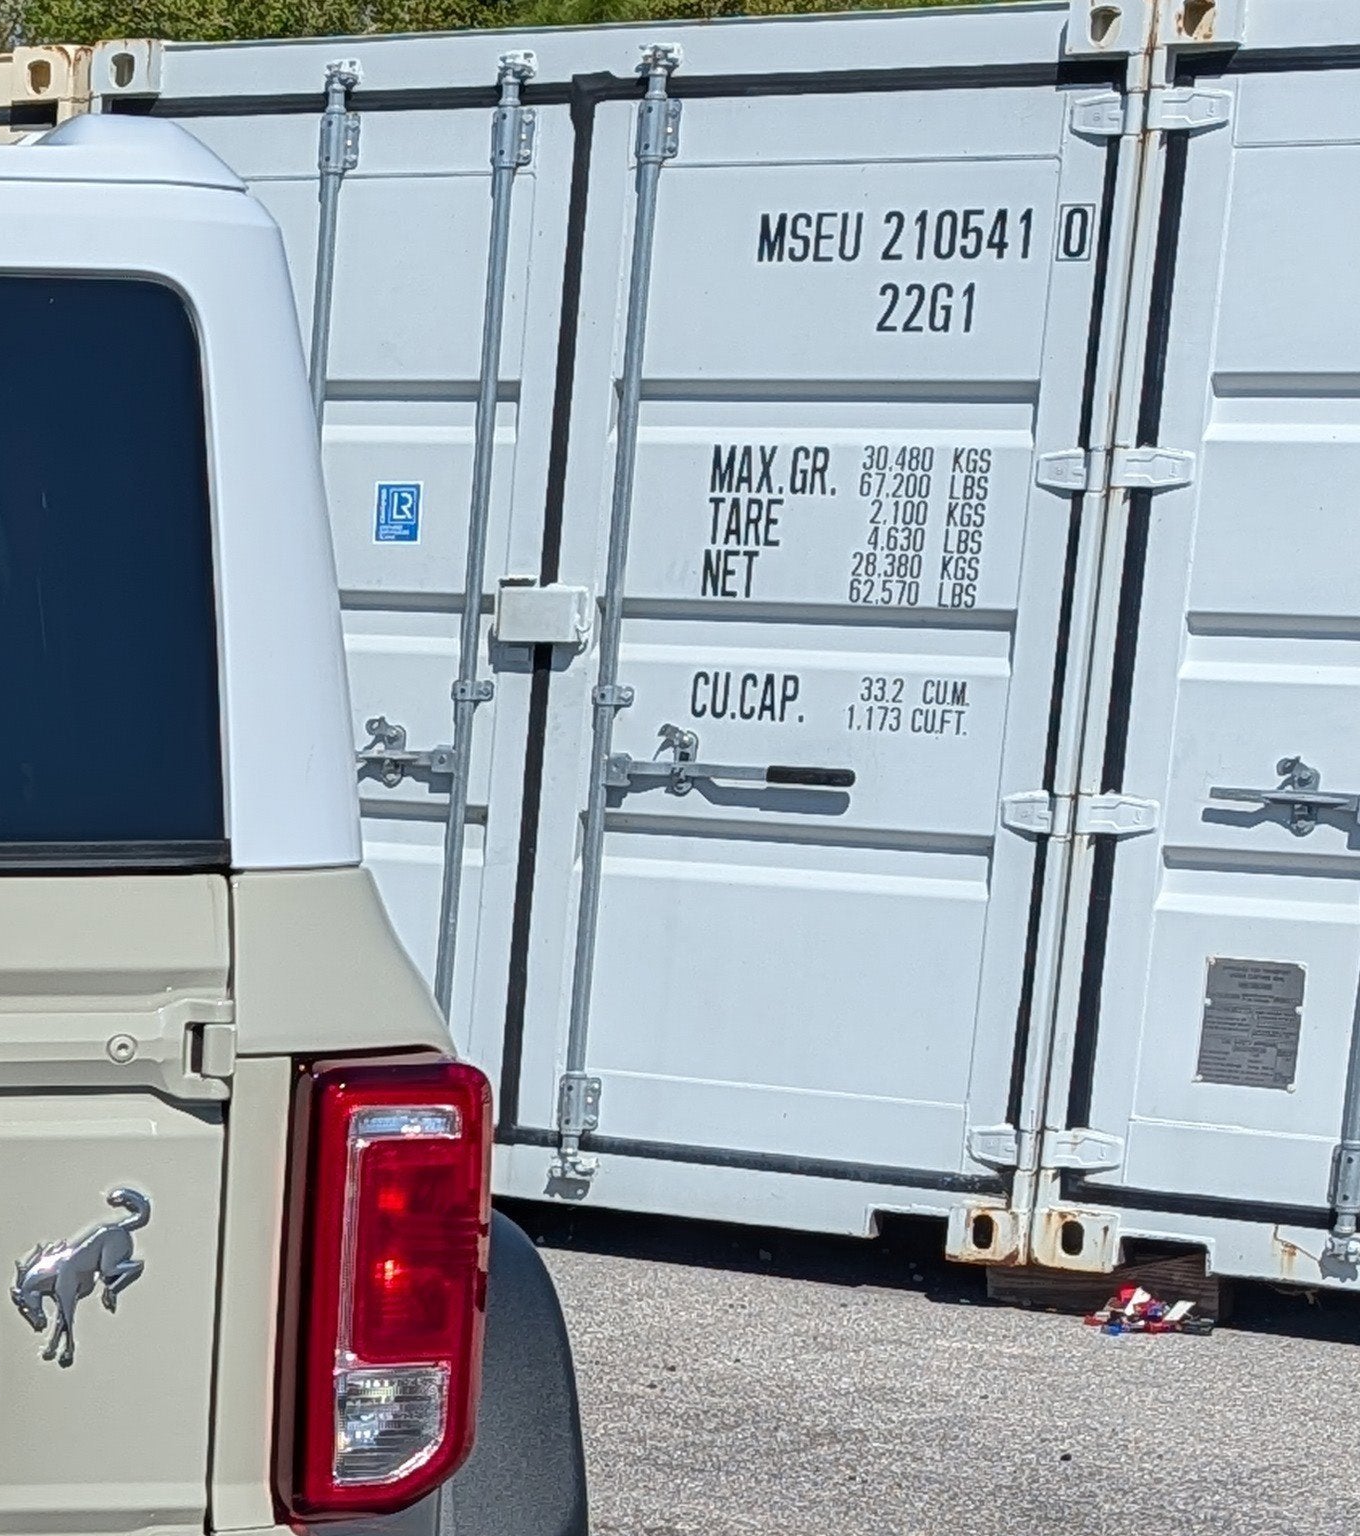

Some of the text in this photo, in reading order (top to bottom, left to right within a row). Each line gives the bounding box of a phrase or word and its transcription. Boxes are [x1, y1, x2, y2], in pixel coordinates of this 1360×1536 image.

[757, 207, 1088, 262] MSEU 210541 0
[876, 282, 975, 333] 22G1
[952, 448, 992, 474] KGS
[949, 475, 989, 501] LBS
[709, 497, 784, 547] TARE
[946, 502, 986, 528] KGS
[943, 528, 983, 554] LBS
[701, 549, 759, 598] NET
[940, 555, 980, 581] KGS
[937, 582, 977, 608] LBS
[691, 671, 804, 723] CU.CAP.
[860, 677, 905, 703] 33.2
